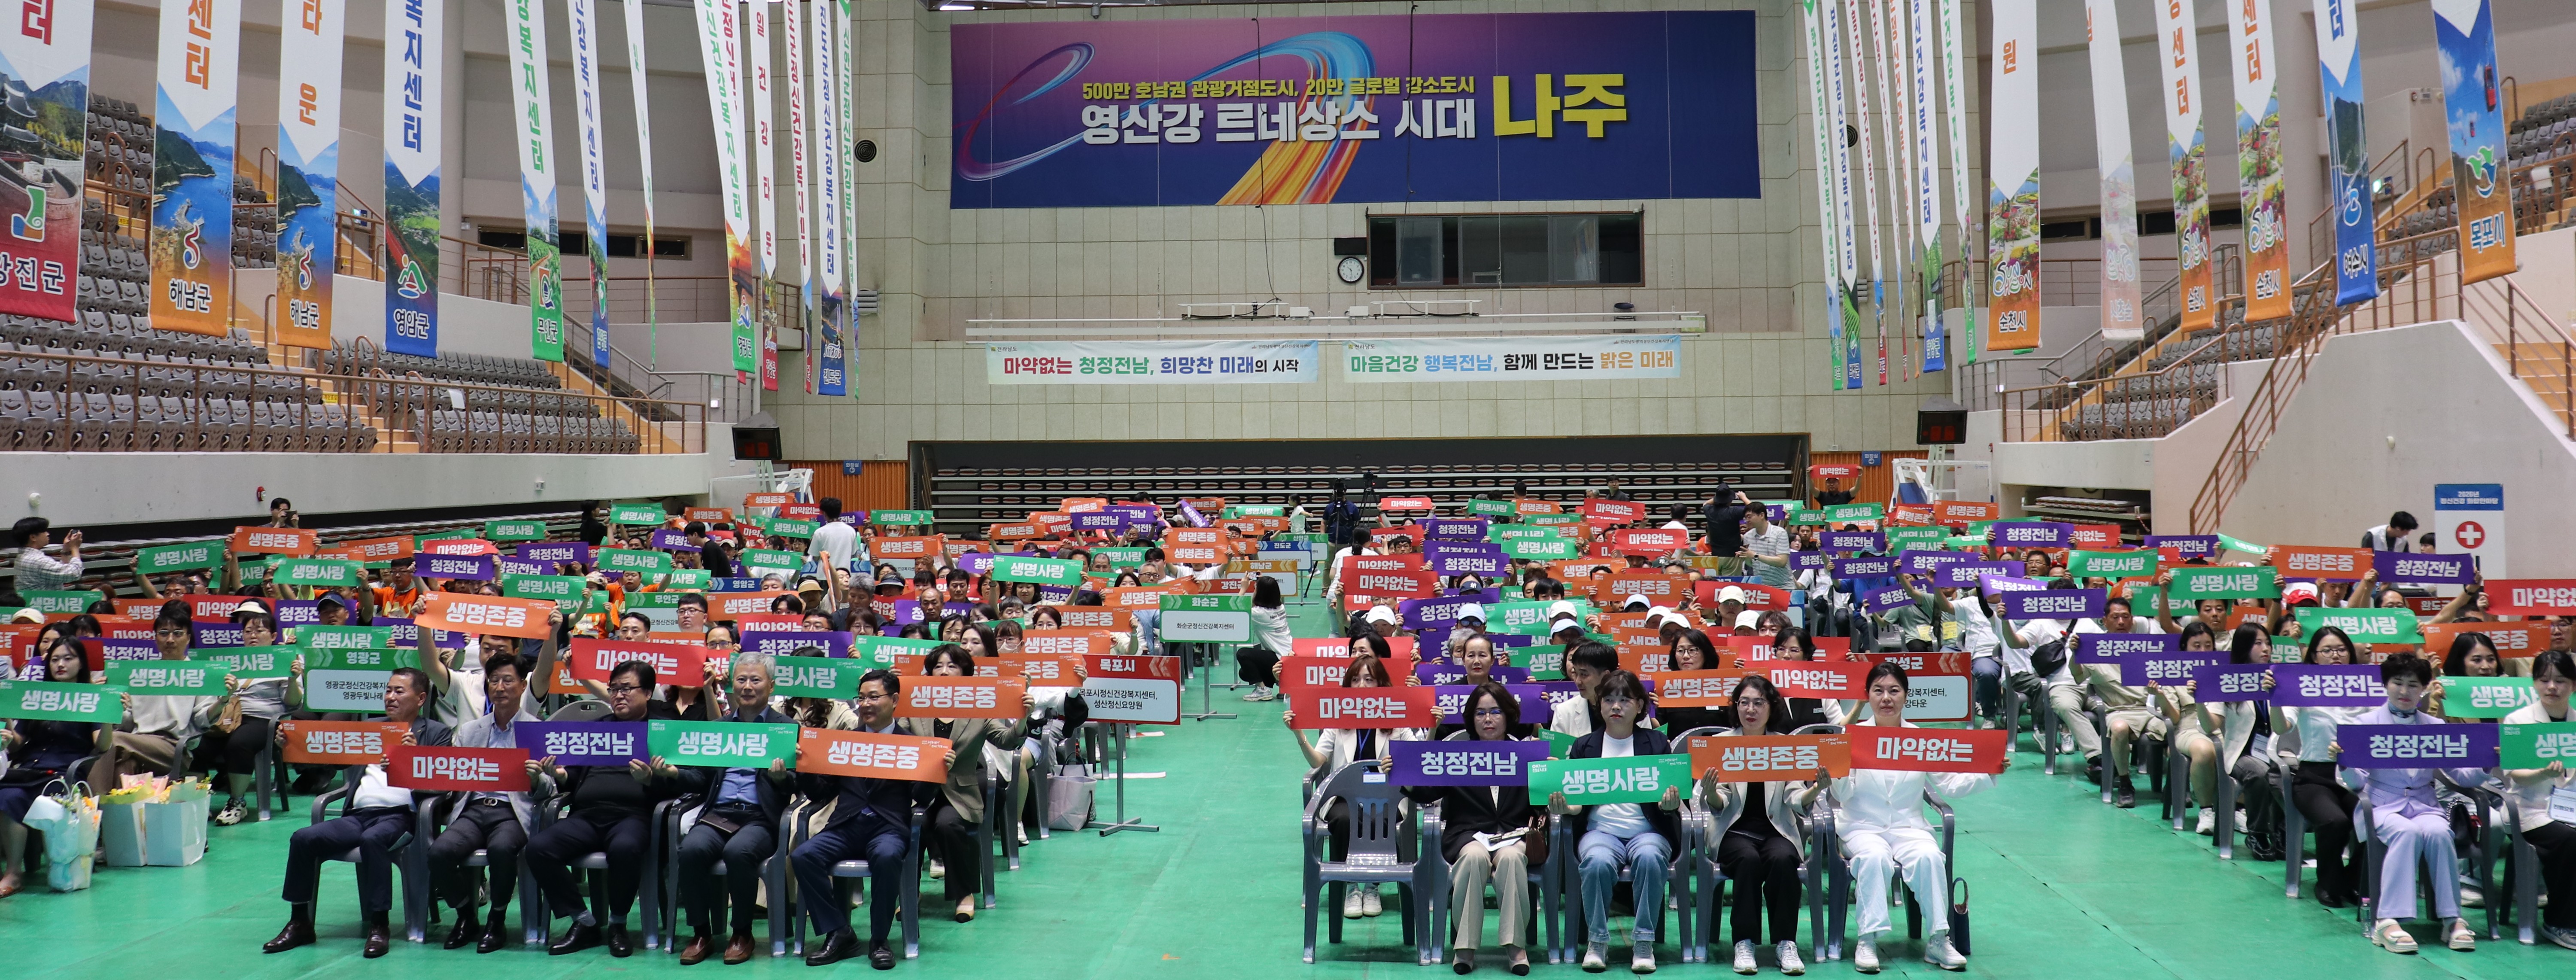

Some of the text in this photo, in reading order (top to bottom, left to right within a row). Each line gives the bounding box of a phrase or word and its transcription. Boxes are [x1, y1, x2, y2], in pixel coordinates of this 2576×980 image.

[2002, 39, 2017, 74] 원
[1083, 76, 1475, 99] 500만 호남권 관광거점도시, 20만 글로벌 강소도시
[1081, 73, 1627, 144] 영산강 르네상스 시대 나주
[2470, 212, 2506, 253] 목포시
[2343, 243, 2369, 279] 여수시
[2257, 269, 2281, 300] 순천시
[168, 280, 211, 314] 해남군
[2188, 285, 2207, 313] 순천시
[289, 298, 319, 329] 해남군
[394, 308, 429, 339] 영암군
[1999, 310, 2027, 333] 순천시
[537, 317, 558, 344] 무안군
[1004, 356, 1300, 376] 마약없는 청정전남, 희망찬 미래의 시작
[1351, 350, 1674, 373] 마음건강 행복전남, 함께 만드는 밝은 미래
[1820, 467, 1849, 476] 마약없는
[755, 495, 786, 504] 생명존중
[1068, 503, 1097, 511] 생명존중
[1391, 499, 1422, 507] 마약없는
[1476, 503, 1507, 511] 생명사랑
[1519, 502, 1551, 512] 생명존중
[620, 510, 655, 521] 생명사랑
[693, 510, 723, 519] 생명존중
[790, 506, 820, 515] 마약없는
[1184, 503, 1205, 527] 청정전남
[1595, 503, 1632, 514] 마약없는
[1835, 507, 1872, 518] 생명사랑
[1946, 505, 1986, 516] 생명존중
[880, 513, 911, 521] 생명사랑
[1082, 516, 1118, 526] 청정전남
[496, 525, 534, 535] 생명사랑
[774, 523, 808, 534] 생명사랑
[1000, 525, 1034, 535] 생명존중
[1438, 524, 1477, 534] 청정전남
[2006, 528, 2057, 541] 청정전남
[248, 533, 299, 548] 생명존중
[1178, 532, 1216, 542] 생명존중
[1629, 533, 1673, 544] 마약없는
[1833, 536, 1874, 548] 청정전남
[437, 542, 484, 555] 마약없는
[529, 547, 574, 561] 청정전남
[881, 541, 924, 553] 생명존중
[1175, 548, 1214, 559] 생명존중
[1517, 542, 1564, 554] 생명사랑
[154, 548, 208, 565] 생명사랑
[612, 551, 659, 566] 생명사랑
[753, 553, 790, 564] 생명사랑
[2086, 558, 2145, 570] 생명사랑
[2288, 554, 2354, 571] 생명존중
[292, 564, 345, 580] 생명사랑
[431, 558, 480, 575] 청정전남
[1010, 563, 1064, 578] 생명사랑
[1445, 559, 1497, 571] 청정전남
[1845, 562, 1888, 575] 청정전남
[2395, 560, 2461, 577] 청정전남
[517, 578, 569, 594] 생명사랑
[732, 578, 755, 589] 영암군
[1359, 575, 1417, 591] 마약없는
[1612, 580, 1670, 594] 생명존중
[2190, 576, 2259, 592] 생명사랑
[30, 597, 83, 612] 생명사랑
[655, 592, 679, 604] 무안군
[1192, 597, 1218, 607] 화순군
[2023, 597, 2086, 612] 청정전남
[446, 603, 526, 628] 생명존중
[1061, 612, 1113, 626] 생명존중
[311, 632, 372, 648] 생명사랑
[1025, 637, 1088, 654] 생명존중
[346, 652, 380, 665] 영광군
[1100, 658, 1135, 672] 목포시
[129, 669, 205, 687] 생명사랑
[1771, 670, 1847, 690] 마약없는
[21, 690, 100, 712] 생명사랑
[910, 686, 996, 708] 생명존중
[1094, 701, 1142, 709] 성산정신요양원
[1319, 698, 1406, 718] 마약없는
[305, 731, 383, 754] 생명존중
[545, 732, 634, 755] 청정전남
[677, 730, 768, 756] 생명사랑
[1876, 738, 1973, 762] 마약없는
[2370, 735, 2469, 759] 청정전남
[828, 741, 919, 768] 생명존중
[1722, 746, 1819, 771] 생명존중
[413, 756, 500, 781] 마약없는
[1421, 751, 1518, 775] 청정전남
[1562, 767, 1660, 794] 생명사랑
